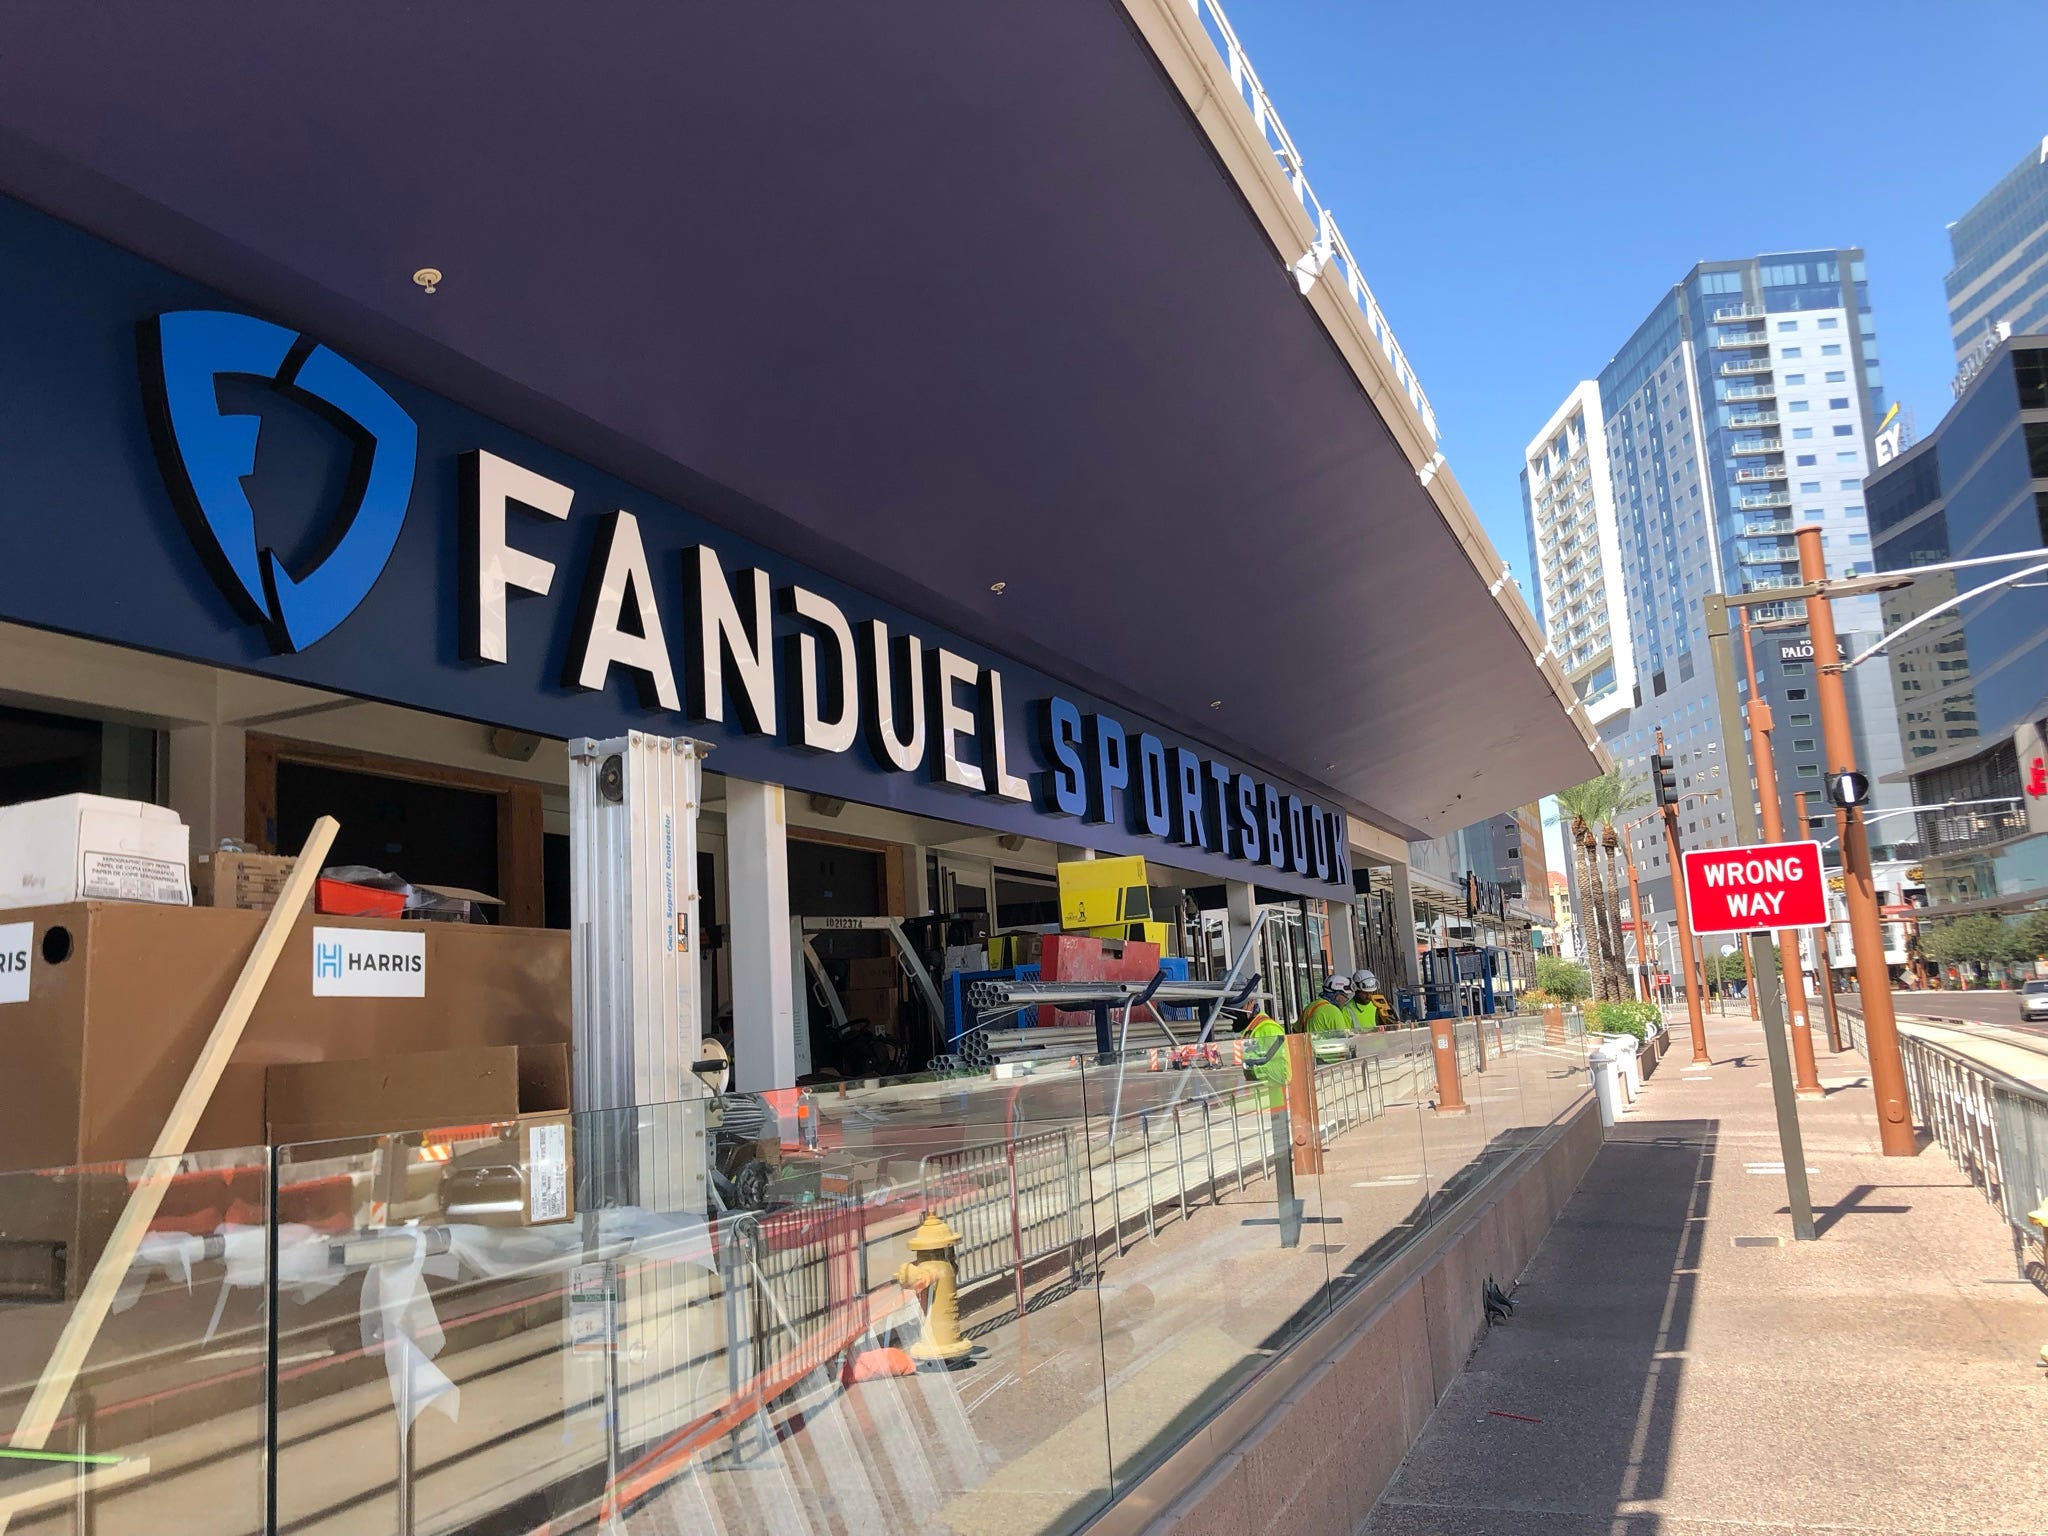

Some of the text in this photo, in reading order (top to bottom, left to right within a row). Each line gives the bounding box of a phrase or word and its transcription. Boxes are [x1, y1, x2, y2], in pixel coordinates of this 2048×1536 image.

[1875, 422, 1900, 468] EY
[1781, 644, 1846, 659] PALOR
[479, 449, 1349, 886] FANDUEL SPORTSBOOK
[1703, 857, 1804, 888] WRONG
[1726, 890, 1785, 918] WAY
[348, 953, 422, 973] HARRIS
